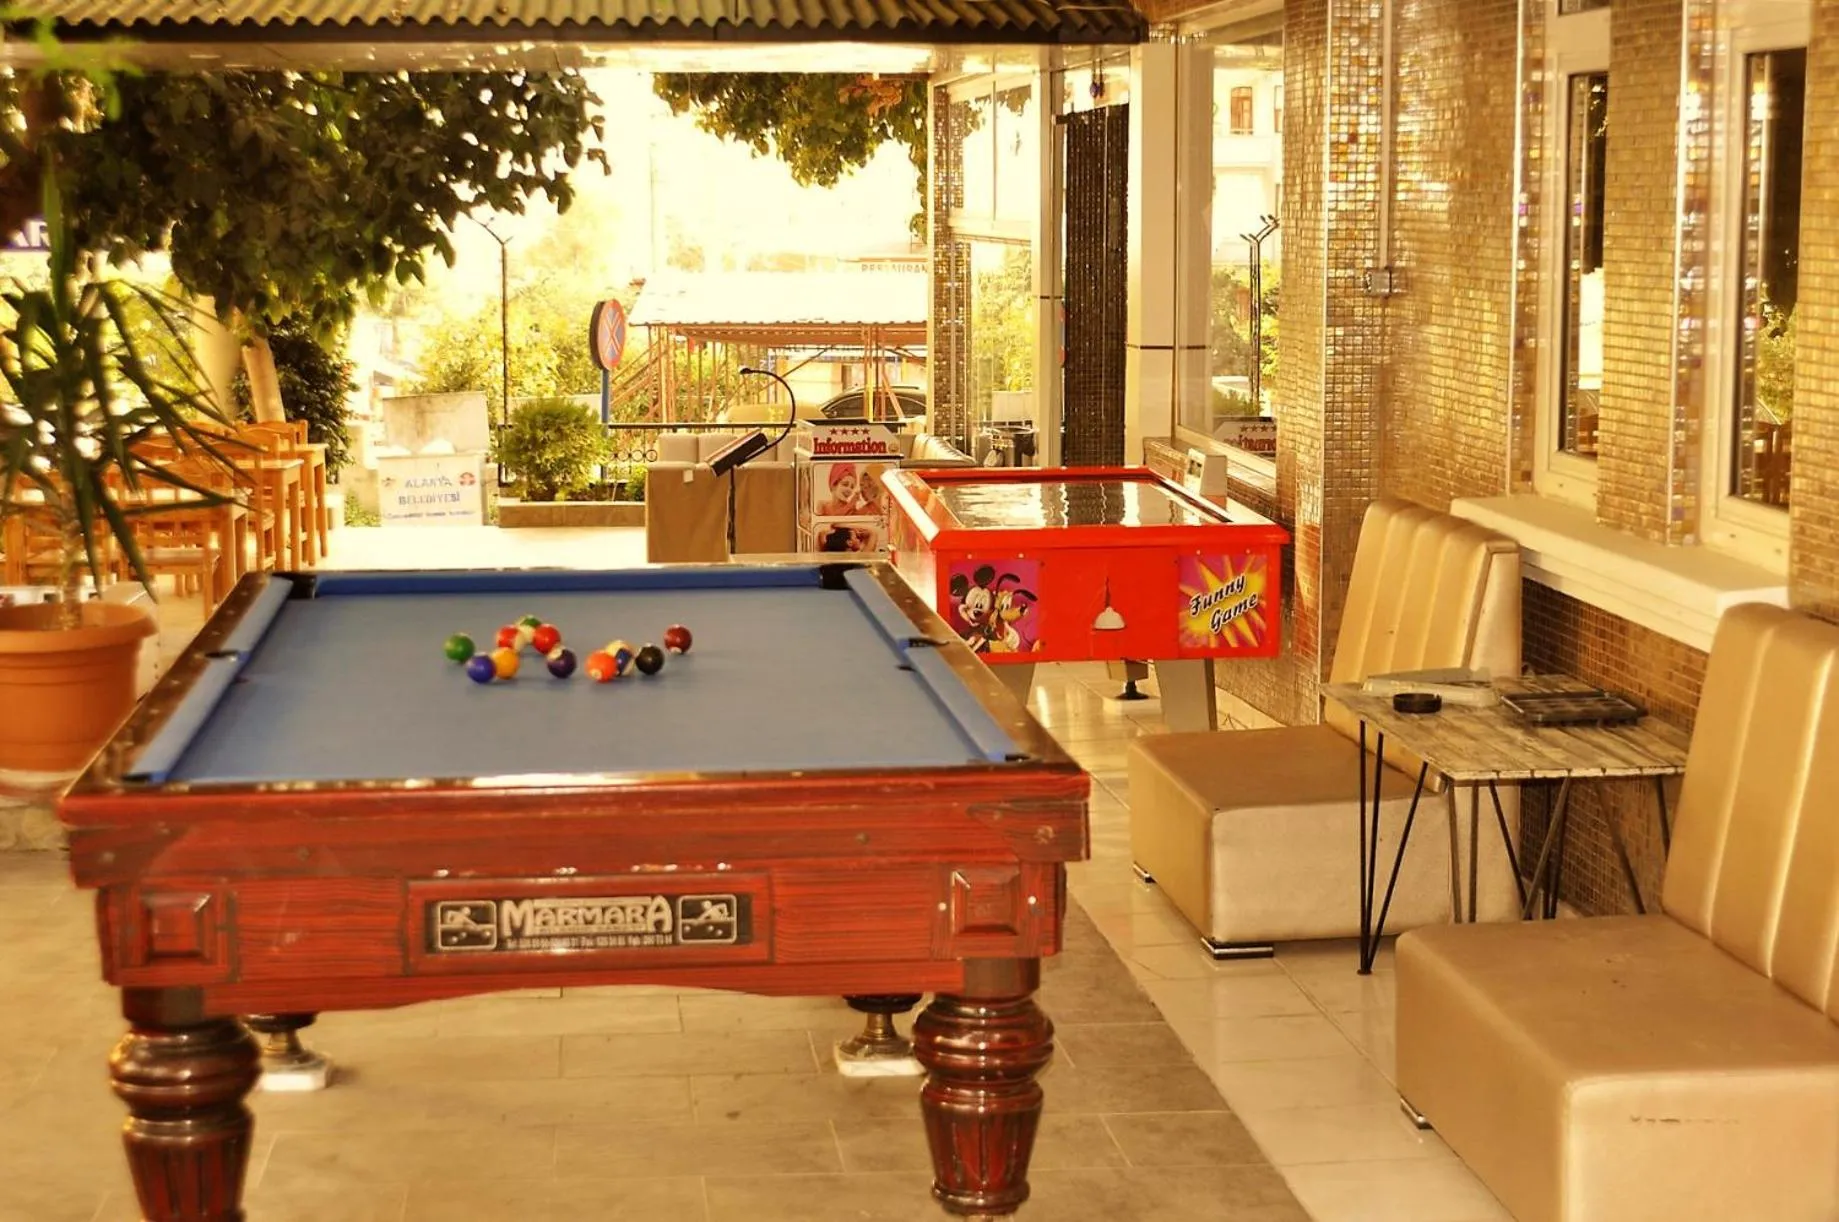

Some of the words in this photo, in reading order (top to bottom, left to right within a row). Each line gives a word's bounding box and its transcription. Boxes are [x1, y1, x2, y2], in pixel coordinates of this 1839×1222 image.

[813, 437, 886, 454] Information
[1190, 574, 1245, 617] Funny
[1209, 593, 1258, 634] Game
[502, 895, 673, 937] MARMARA
